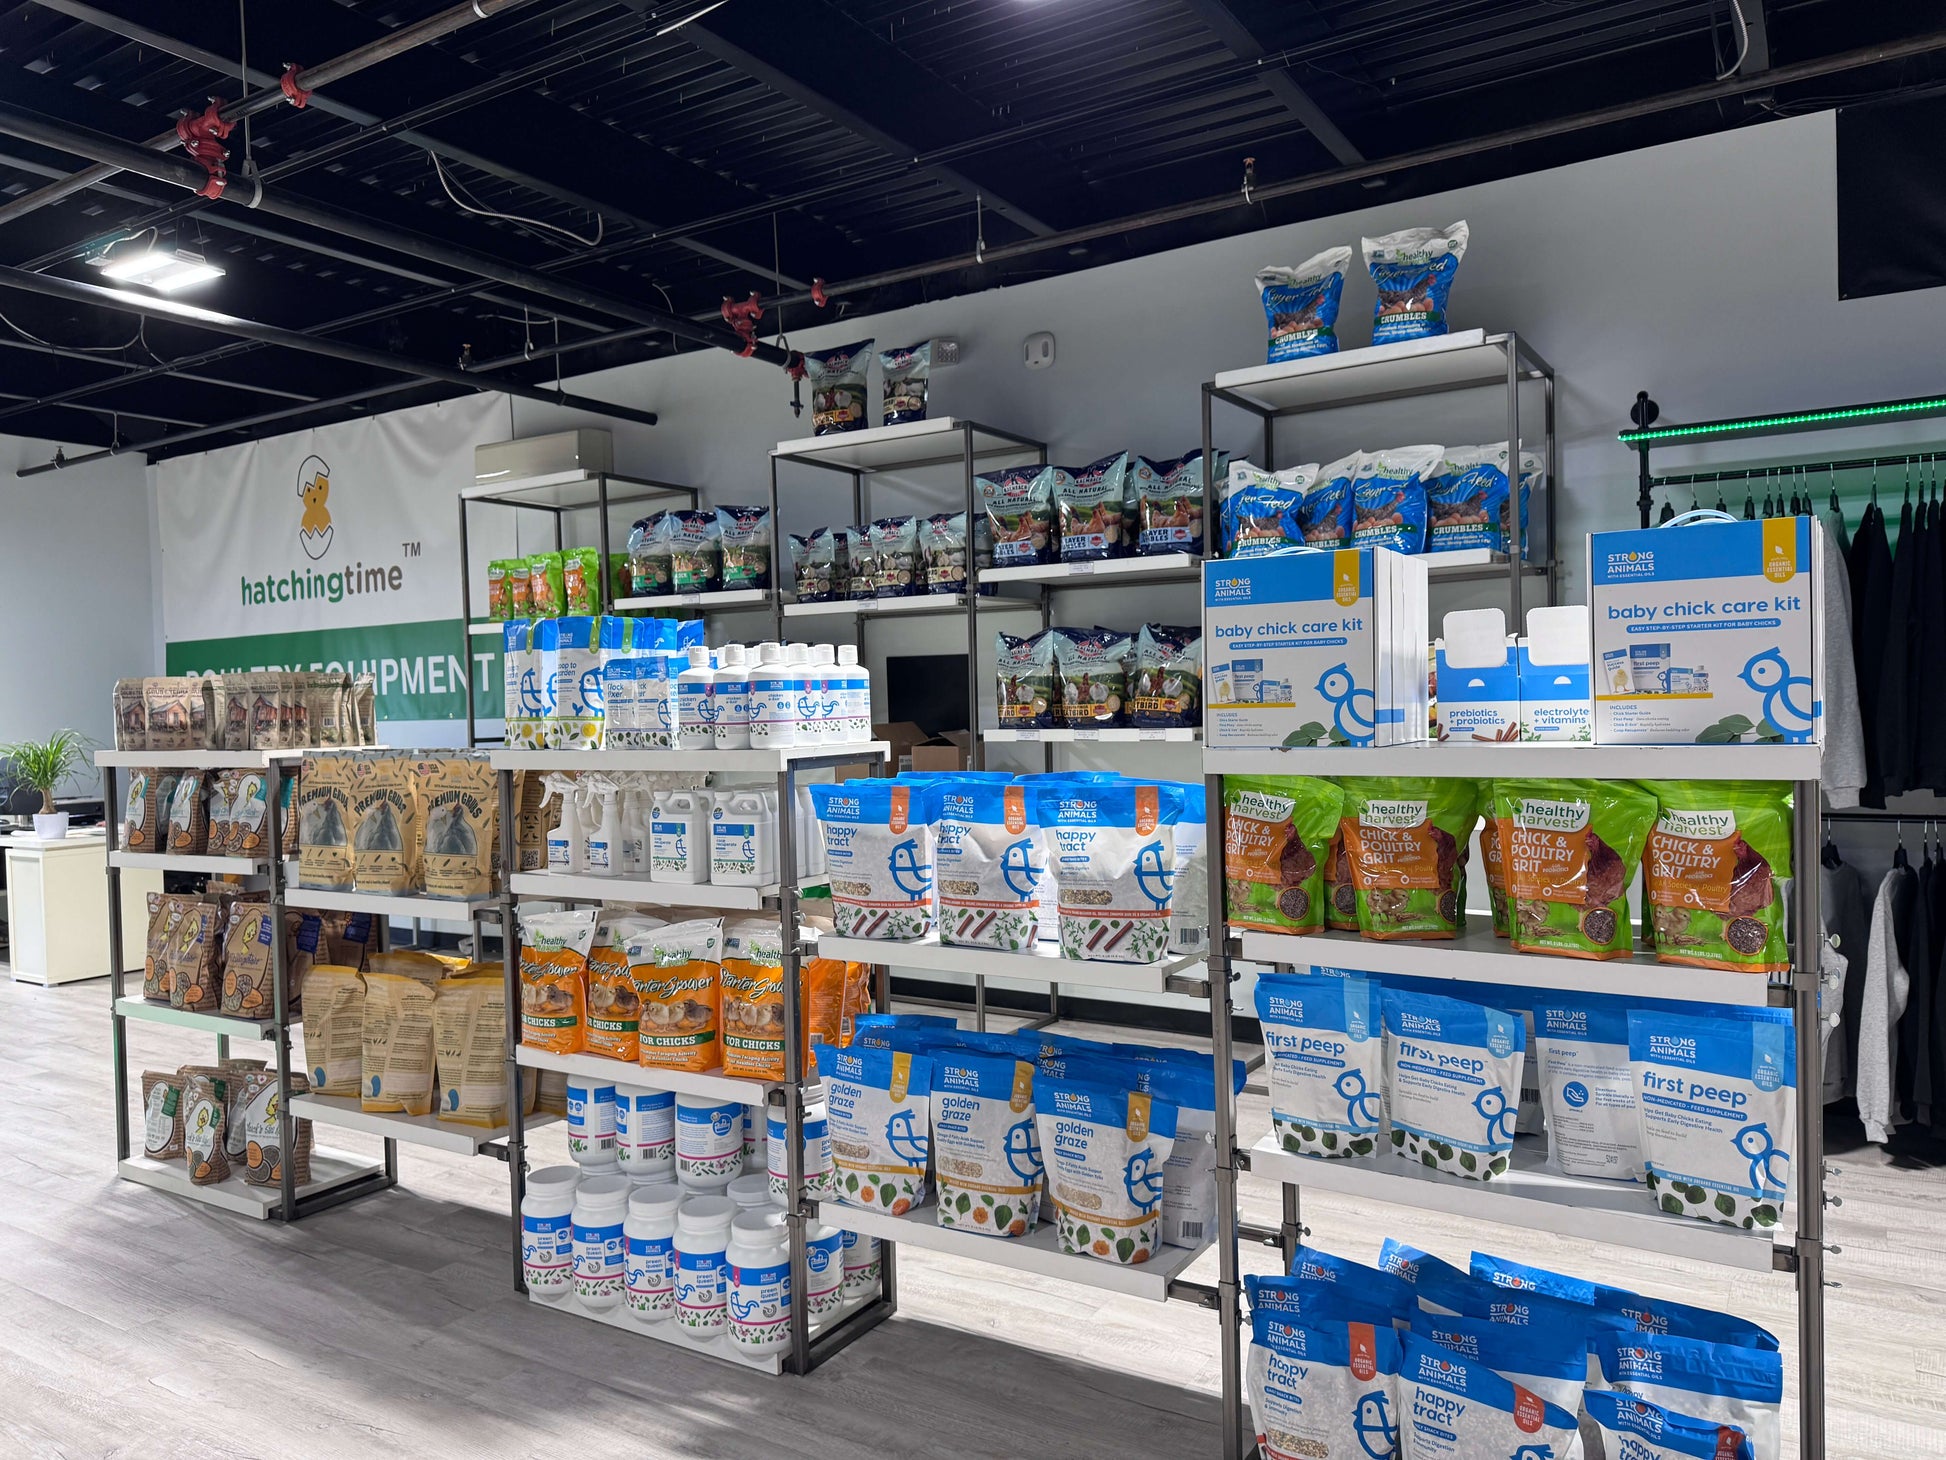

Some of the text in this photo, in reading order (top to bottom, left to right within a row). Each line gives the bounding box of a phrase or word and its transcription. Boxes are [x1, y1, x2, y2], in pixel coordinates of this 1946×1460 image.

[1403, 249, 1433, 262] healthy
[1381, 312, 1427, 324] CRUMBLES
[1275, 329, 1319, 345] CRUMBLES
[1382, 466, 1414, 478] healthy
[1354, 525, 1398, 539] CRUMBLES
[1434, 524, 1484, 535] CRUMBLES
[402, 541, 421, 558] TM
[1608, 551, 1654, 564] STRONG
[1607, 563, 1655, 574] ANIMALS
[241, 563, 403, 606] hatchingtime
[1214, 587, 1251, 597] ANIMALS
[1608, 596, 1801, 621] baby chick care kit
[1215, 617, 1363, 639] baby chick care kit
[1450, 708, 1498, 719] prebiotics
[1534, 707, 1590, 719] electrolyte
[1456, 716, 1506, 726] probiotics
[826, 806, 860, 815] ANIMALS
[1241, 793, 1289, 814] healthy
[1371, 803, 1422, 817] healthy
[1057, 810, 1097, 819] ANIMALS
[1234, 804, 1281, 820] harvest
[1526, 802, 1585, 820] healthy
[1226, 817, 1270, 835] CHICK &
[1364, 813, 1416, 825] harvest
[1518, 813, 1576, 829] harvest
[1670, 811, 1729, 827] healthy
[826, 824, 857, 838] happy
[1359, 829, 1412, 842] CHICK &
[1664, 821, 1723, 836] harvest
[827, 837, 850, 847] tract
[1056, 829, 1096, 843] happy
[1226, 832, 1275, 847] POULTRY
[1511, 830, 1567, 848] CHICK &
[1226, 842, 1248, 856] GRIT
[1361, 839, 1421, 853] POULTRY
[1652, 835, 1714, 855] CHICK &
[1363, 852, 1395, 865] GRIT
[1511, 845, 1574, 862] POULTRY
[1652, 849, 1721, 869] POULTRY
[1513, 859, 1541, 873] GRIT
[1652, 862, 1684, 879] GRIT
[541, 935, 568, 945] healthy
[634, 975, 714, 999] arter Grower
[720, 967, 785, 999] Starter Grow
[1269, 997, 1303, 1008] STRONG
[1269, 1007, 1303, 1018] ANIMALS
[1546, 1009, 1587, 1022] STRONG
[528, 1017, 556, 1027] CHICKS
[592, 1021, 622, 1031] CHICKS
[1546, 1021, 1587, 1031] ANIMALS
[658, 1036, 696, 1046] CHICKS
[726, 1037, 781, 1050] FOR CHICKS
[1266, 1031, 1345, 1057] first peep
[1650, 1035, 1696, 1048] STRONG
[1400, 1041, 1484, 1074] first peep
[1650, 1046, 1696, 1058] ANIMALS
[944, 1066, 979, 1078] STRONG
[1400, 1062, 1483, 1084] NON-MEDICATED FEED SUPPLEMENT
[1755, 1074, 1781, 1083] ESSENTIAL
[1757, 1068, 1780, 1077] ORGANIC
[944, 1077, 979, 1088] ANIMALS
[1643, 1071, 1747, 1108] first peep
[1761, 1080, 1773, 1088] OILS
[831, 1083, 862, 1099] golden
[828, 1095, 855, 1109] graze
[942, 1096, 981, 1111] golden
[1643, 1095, 1687, 1108] NON-MEDICATED
[1690, 1104, 1705, 1112] FEED
[1705, 1106, 1745, 1120] SUPPLEMENT
[941, 1108, 971, 1121] graze
[1056, 1121, 1094, 1138] golden
[1667, 1117, 1679, 1126] Early
[1680, 1119, 1704, 1131] Digestive
[1704, 1125, 1723, 1134] Health
[1054, 1134, 1088, 1149] graze
[1493, 1272, 1536, 1291] STRONG
[1258, 1289, 1299, 1303] STRONG
[1268, 1321, 1306, 1338] STRONG
[1354, 1357, 1372, 1366] ORGANIC
[1617, 1347, 1662, 1362] STRONG
[1420, 1354, 1467, 1375] STRONG
[1267, 1368, 1297, 1389] tract
[1418, 1367, 1467, 1387] ANIMALS
[1415, 1386, 1466, 1417] happy
[1413, 1401, 1453, 1426] tract
[1517, 1410, 1541, 1423] ESSENTIAL
[1519, 1405, 1540, 1416] ORGANIC
[1617, 1411, 1662, 1434] ANIMALS
[1423, 1425, 1454, 1439] SNACK BITES
